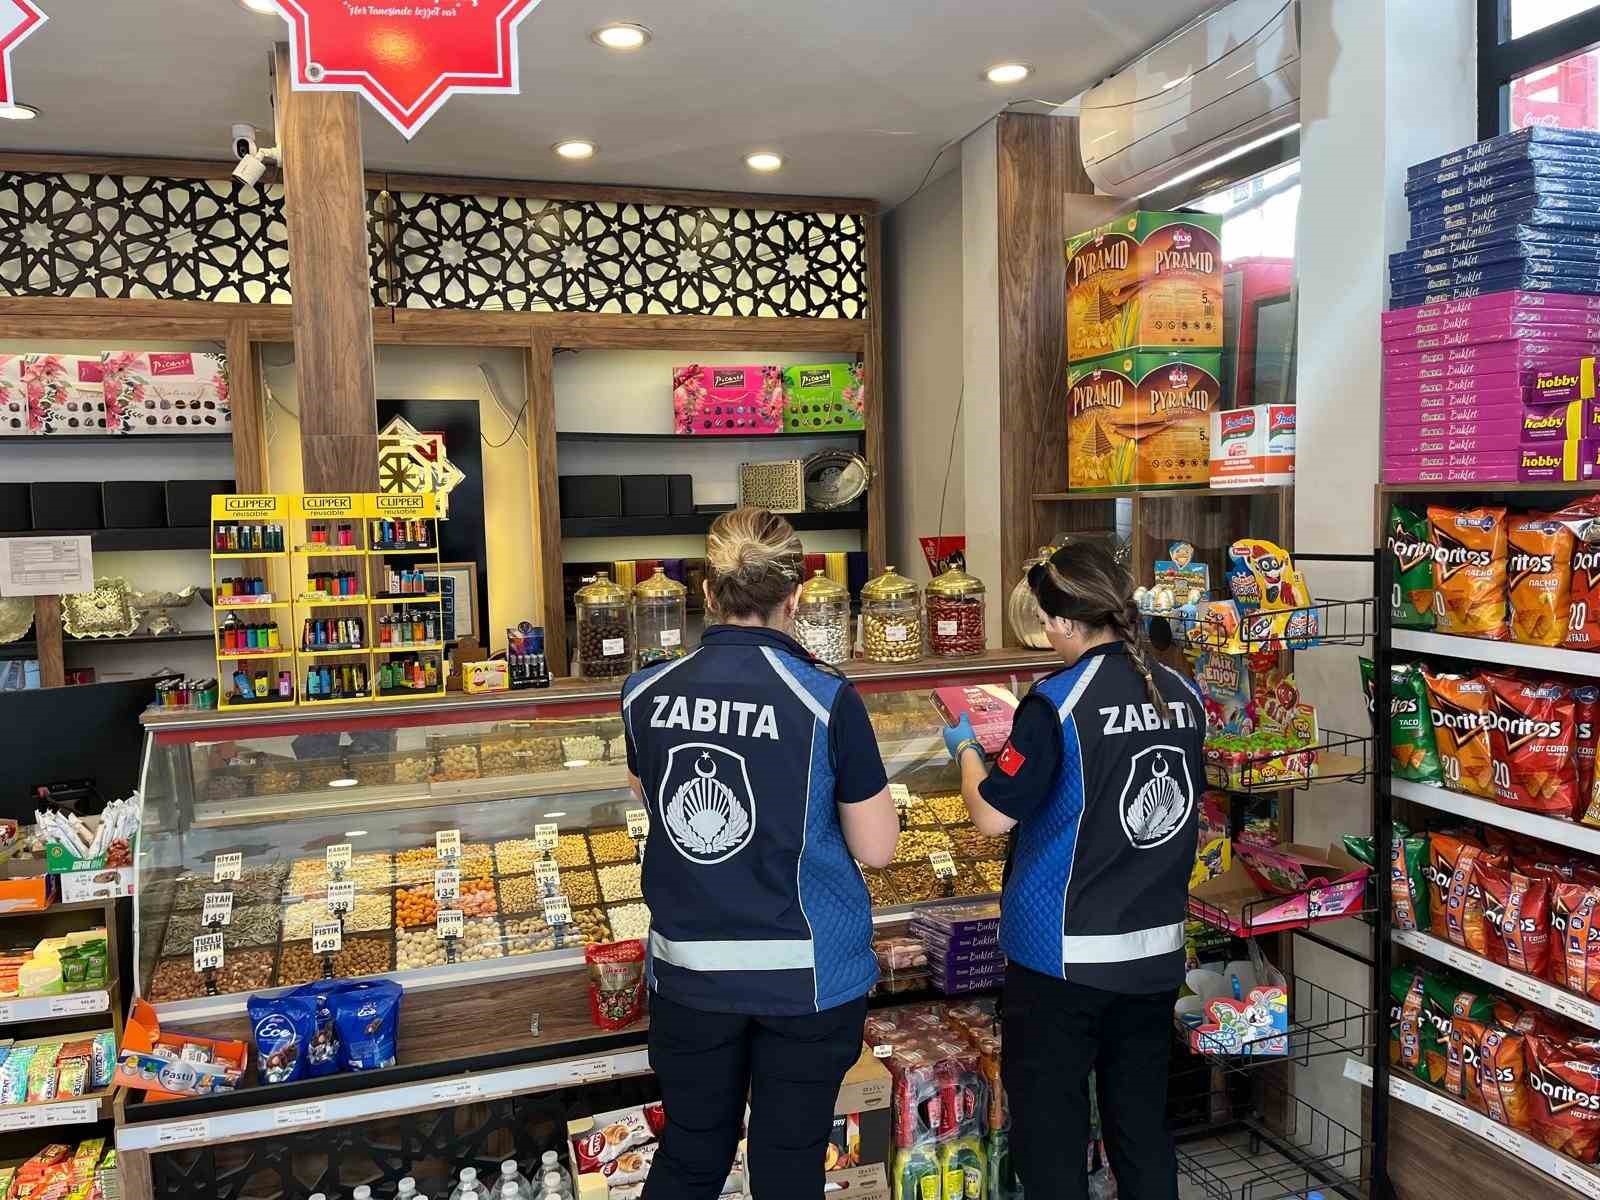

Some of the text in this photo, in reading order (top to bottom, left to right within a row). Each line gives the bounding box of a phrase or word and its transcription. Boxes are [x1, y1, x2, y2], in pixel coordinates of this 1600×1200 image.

[1075, 240, 1129, 286] PYRAMID
[1155, 250, 1213, 274] PYRAMID
[1536, 374, 1579, 389] hobby
[1074, 379, 1124, 417] PYRAMID
[1151, 390, 1209, 415] PYRAMID
[1524, 415, 1564, 429] hobby
[1522, 455, 1562, 468] hobby
[229, 499, 273, 509] CLIPPER
[306, 498, 349, 508] CLIPPER
[379, 497, 421, 507] CLIPPER
[310, 509, 345, 517] reusable
[384, 508, 417, 516] reusable
[650, 695, 780, 741] ZABITA
[1488, 711, 1561, 738] Doritos
[328, 901, 349, 911] 339
[205, 912, 225, 923] 149
[314, 926, 340, 936] FISTIK
[195, 935, 221, 945] TUZLU
[313, 939, 336, 950] 149
[195, 943, 222, 953] FISTIK
[195, 956, 218, 968] 119
[260, 1022, 291, 1038] Ece
[162, 1069, 194, 1082] Pastil
[1530, 1072, 1600, 1110] Doritos
